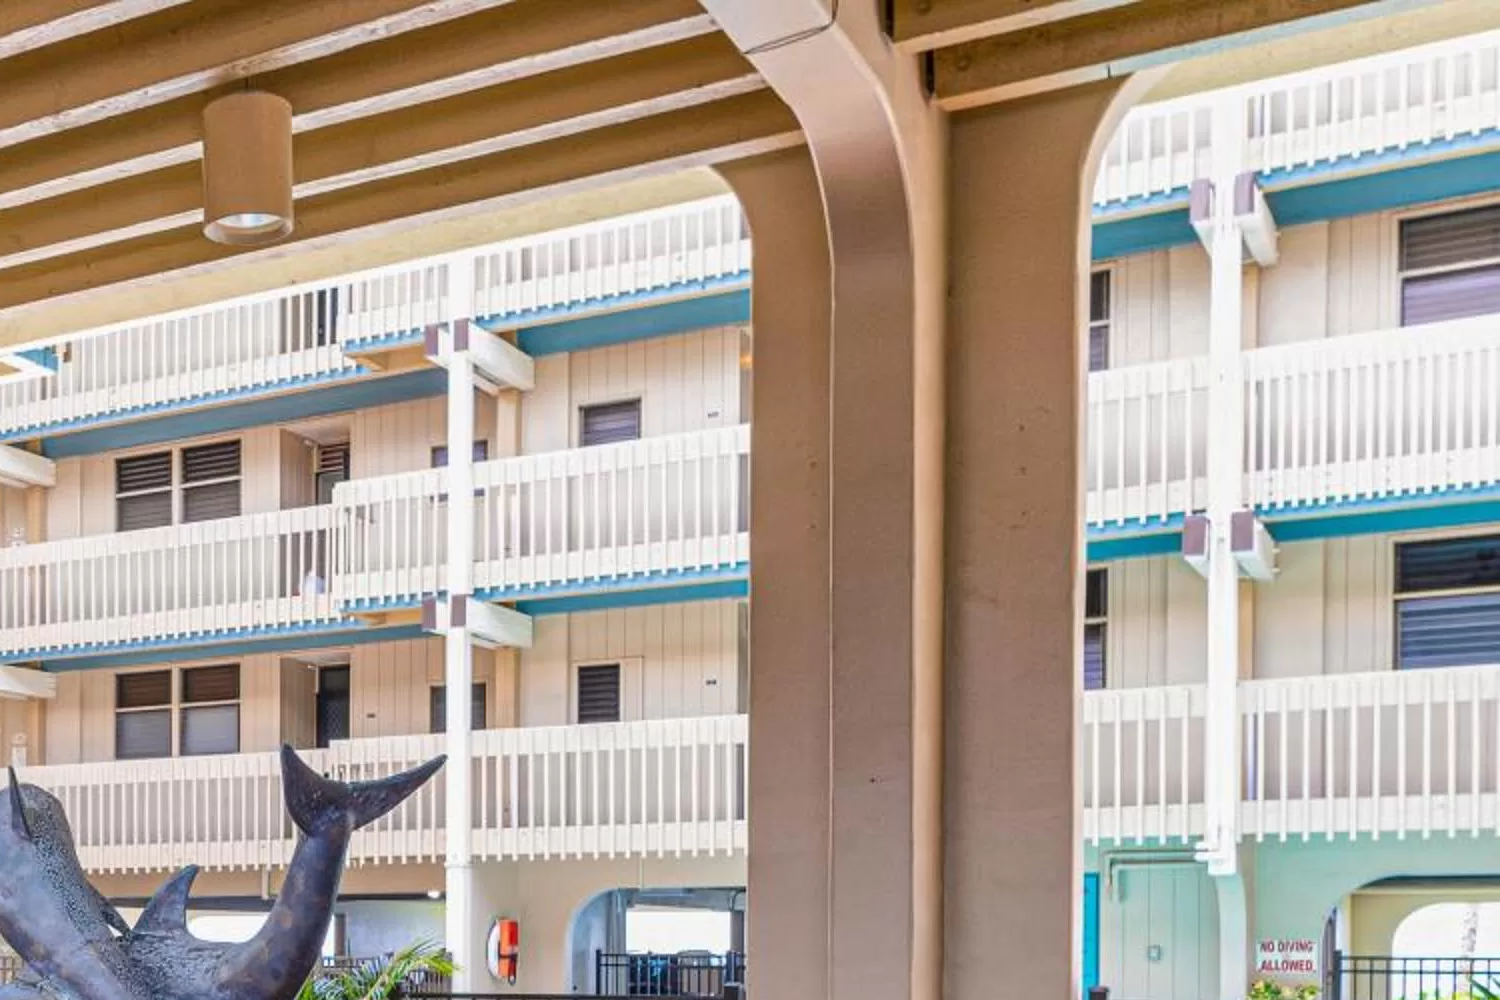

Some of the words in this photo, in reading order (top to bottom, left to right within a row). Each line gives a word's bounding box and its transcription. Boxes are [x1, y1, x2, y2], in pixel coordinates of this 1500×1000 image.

[1260, 940, 1275, 952] NO
[1278, 940, 1313, 952] DIVING
[1261, 959, 1313, 972] ALLOWED
